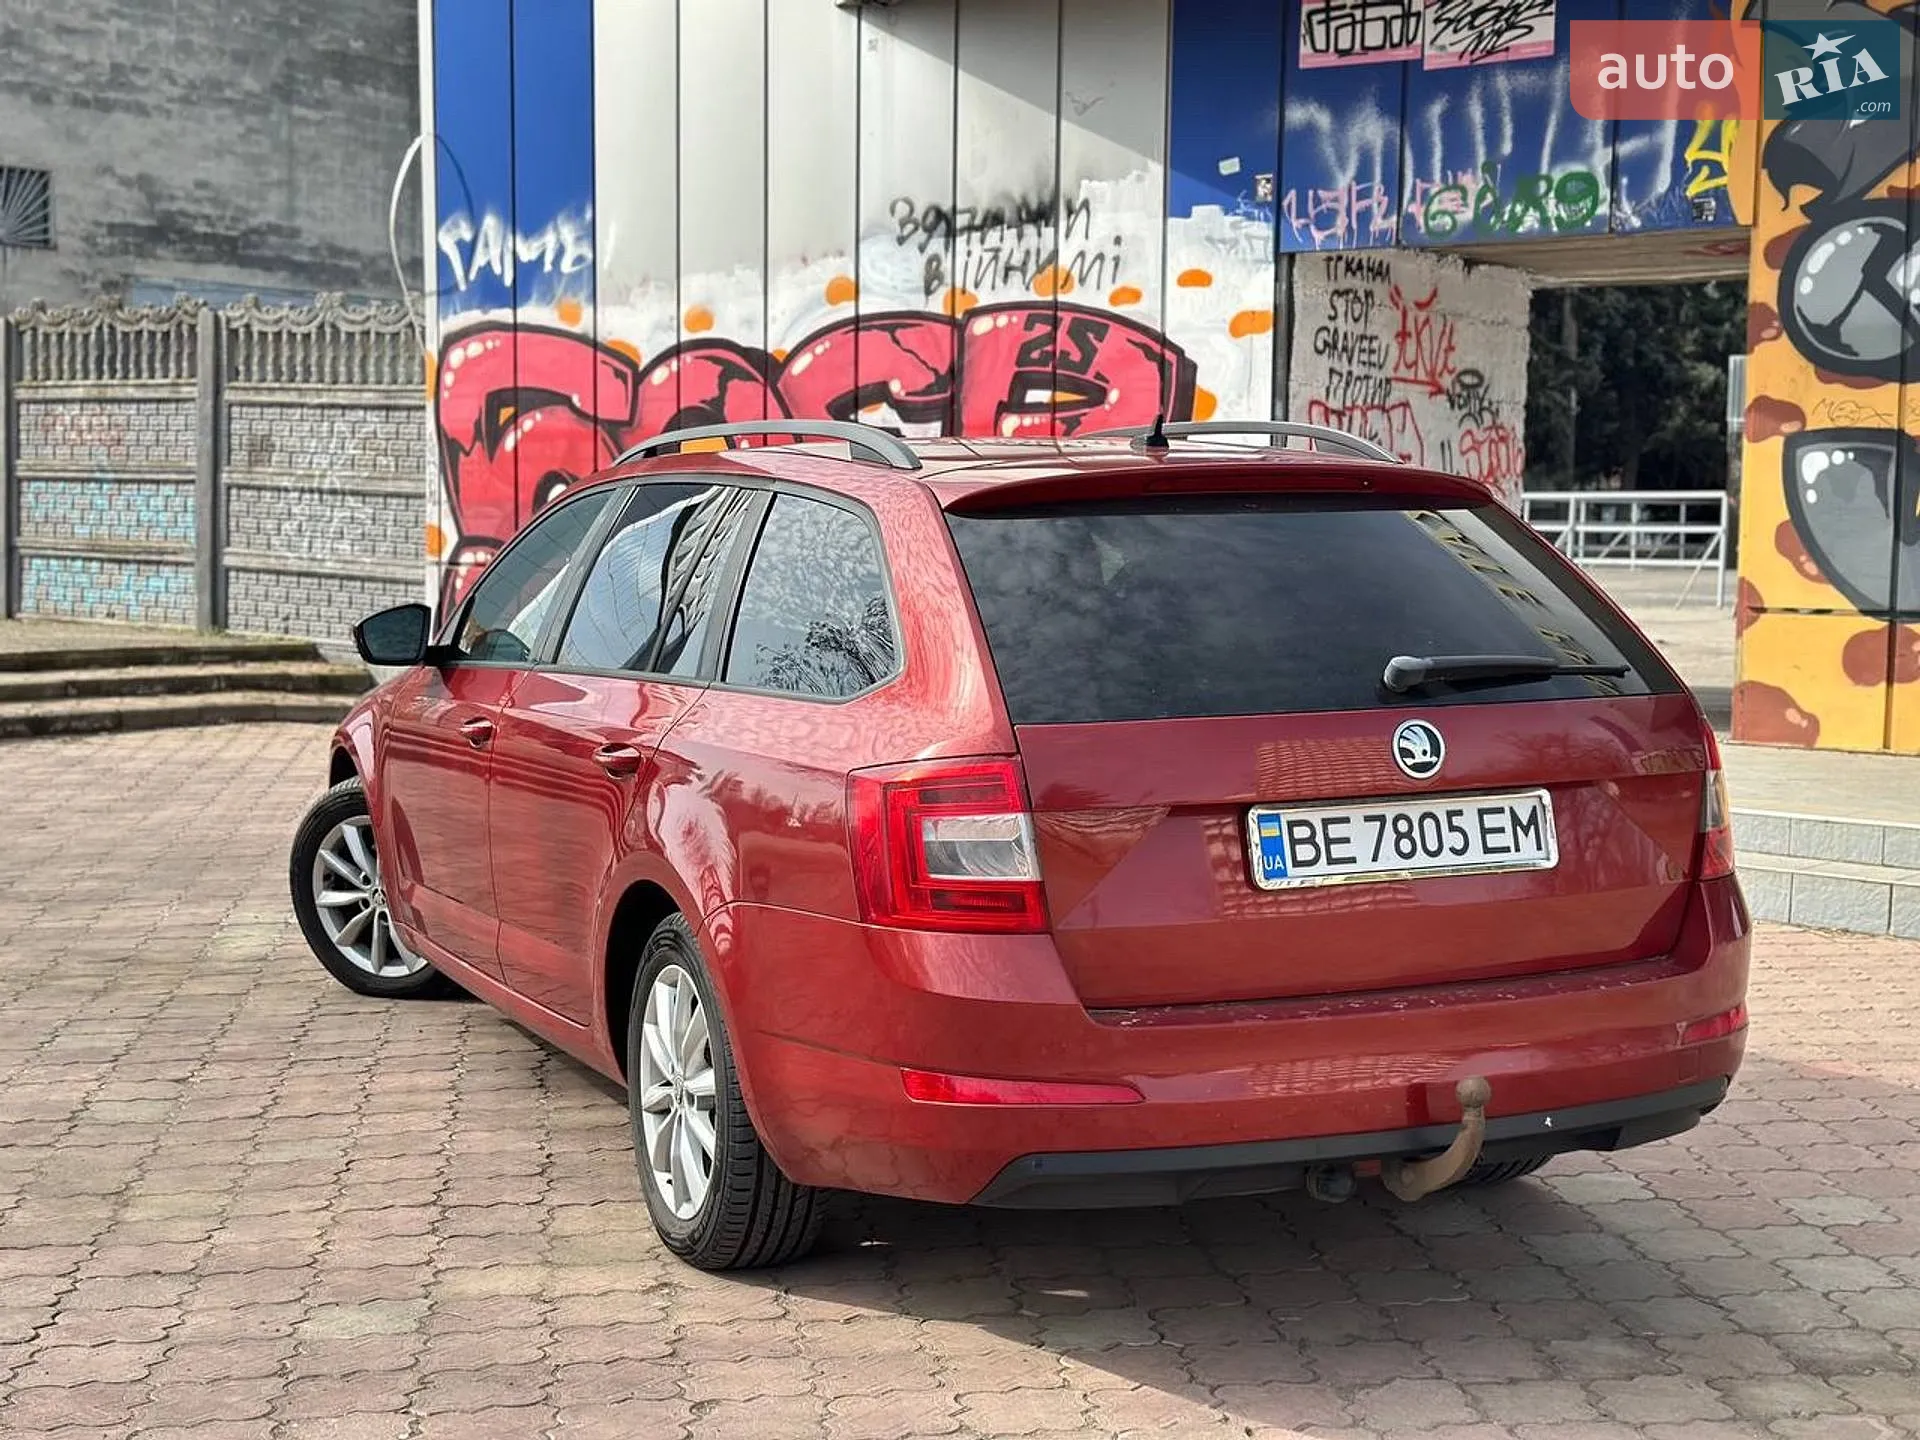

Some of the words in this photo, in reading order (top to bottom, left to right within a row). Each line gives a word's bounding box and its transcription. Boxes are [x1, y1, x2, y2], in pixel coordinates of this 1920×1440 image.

[1328, 288, 1375, 332] STOP
[1286, 816, 1358, 868] BE
[1363, 808, 1470, 862] 7805
[1477, 804, 1544, 855] EM
[1263, 855, 1285, 871] UA
